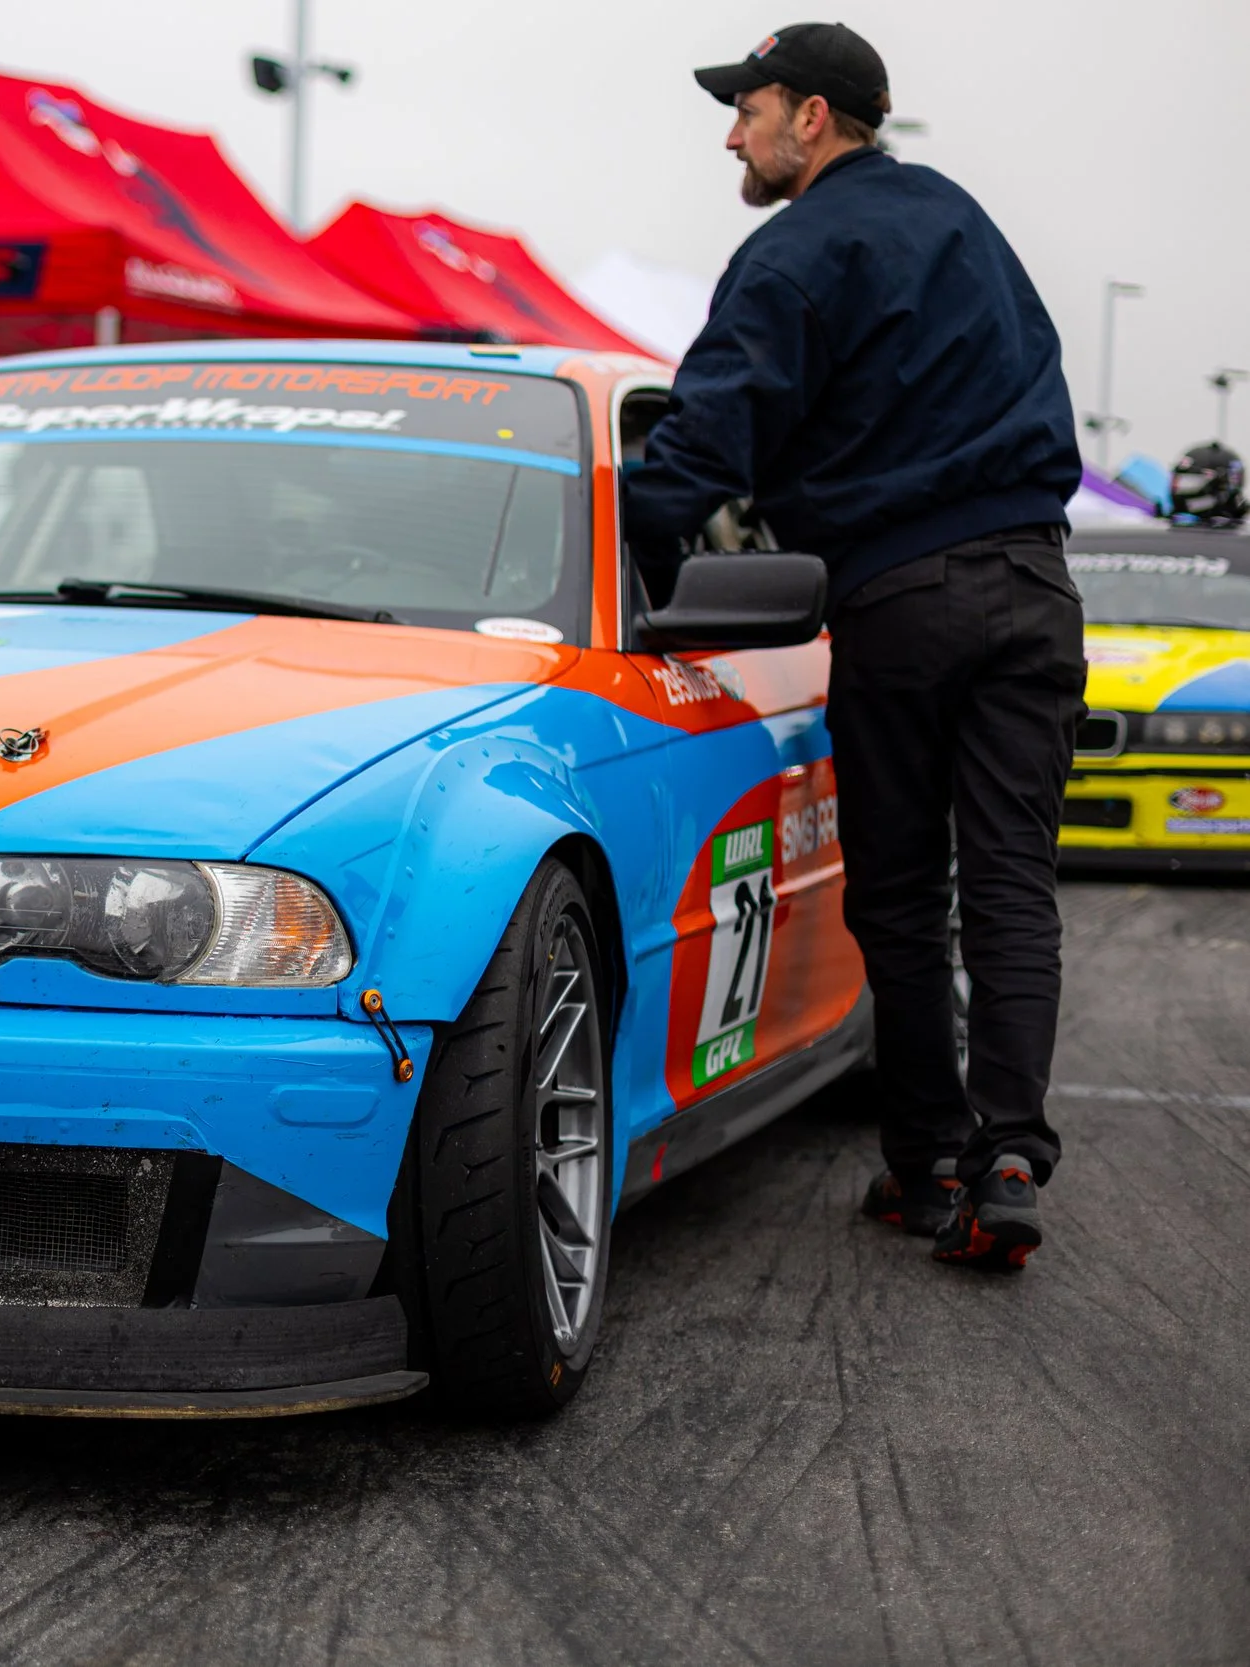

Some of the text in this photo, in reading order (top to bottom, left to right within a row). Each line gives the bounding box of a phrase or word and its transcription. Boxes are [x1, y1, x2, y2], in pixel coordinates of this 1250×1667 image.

[70, 367, 193, 393] LOOP
[193, 366, 511, 405] MOTORSPORT
[725, 824, 764, 867] WRL
[720, 874, 775, 1028] 21
